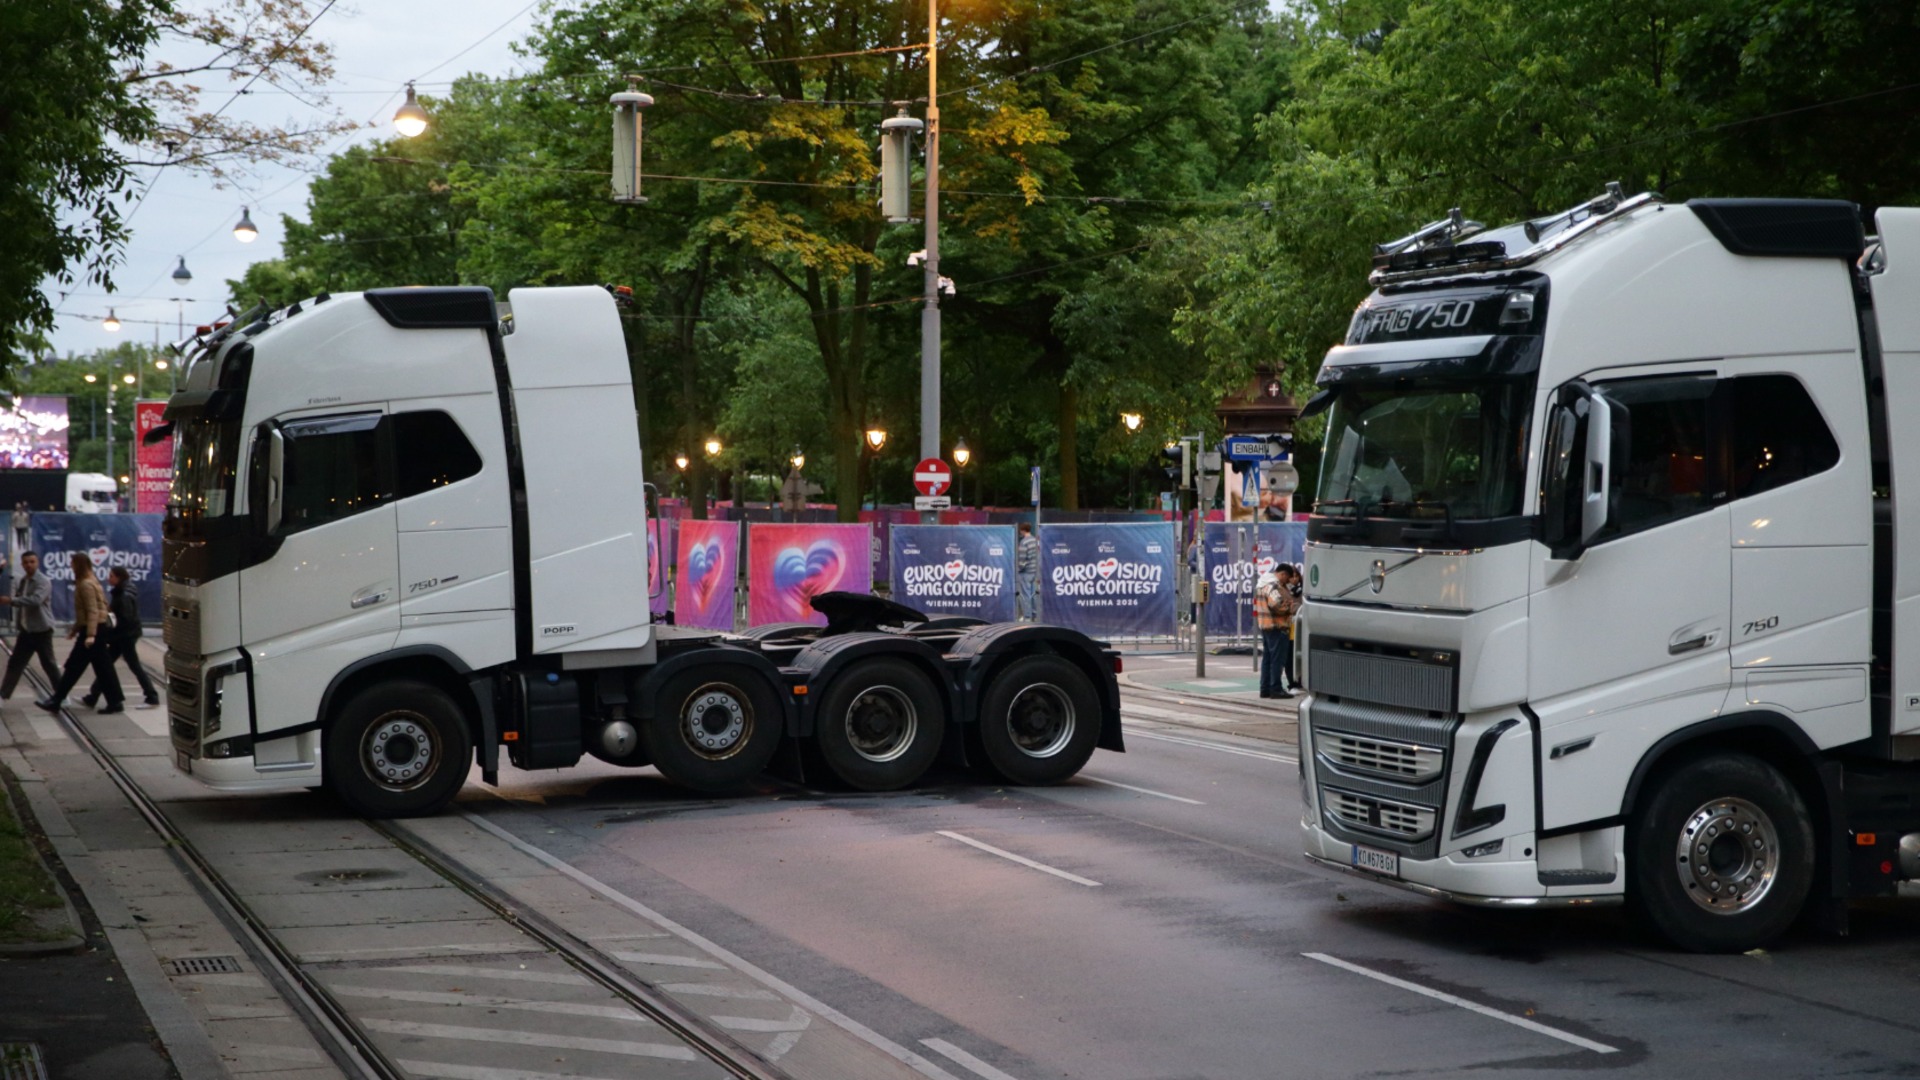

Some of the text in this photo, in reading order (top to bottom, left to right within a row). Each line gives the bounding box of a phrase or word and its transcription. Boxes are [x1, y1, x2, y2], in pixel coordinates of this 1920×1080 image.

[1369, 301, 1475, 333] FH16 750
[1235, 444, 1269, 453] EINBAHN
[138, 463, 172, 478] Vienna
[147, 480, 171, 492] POINT
[46, 567, 76, 581] SON
[408, 578, 438, 593] 750
[906, 582, 1002, 597] SONG CONTEST
[1055, 580, 1161, 597] SONG CONTEST
[1077, 599, 1113, 607] VIENNA
[543, 626, 575, 635] POPP
[1742, 615, 1779, 636] 750
[1372, 852, 1385, 869] 678
[1386, 856, 1395, 872] GX
